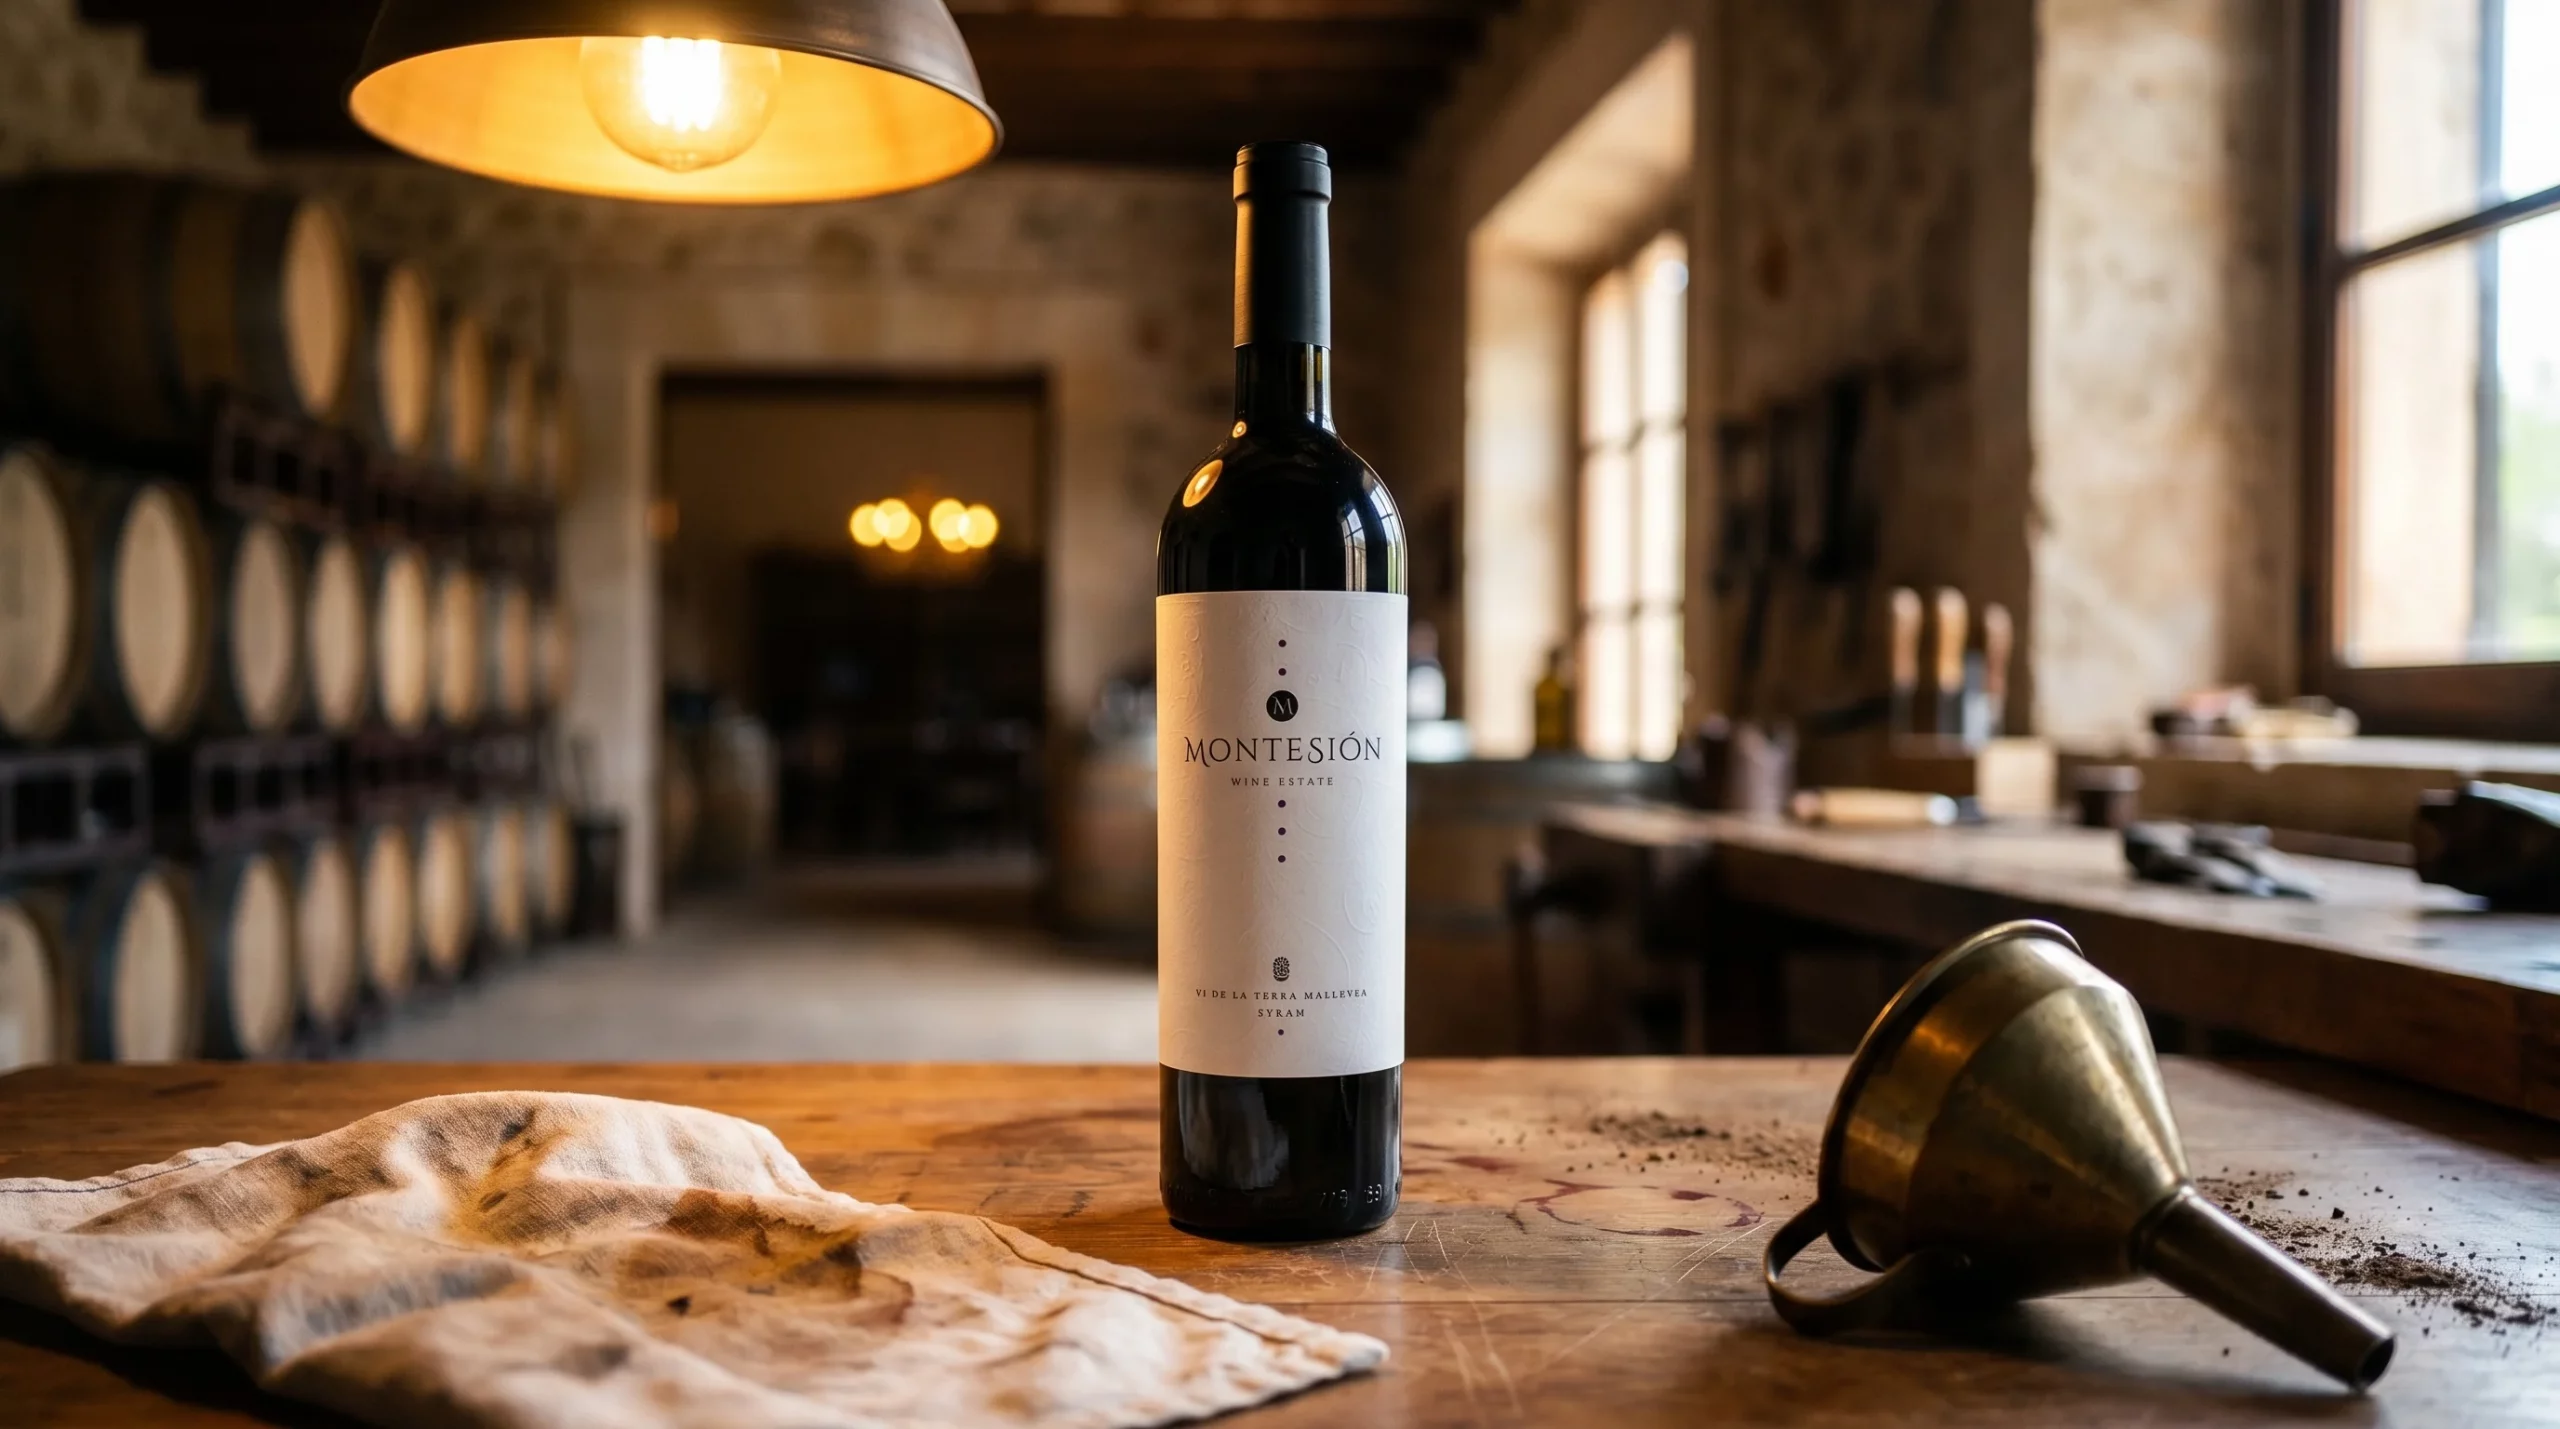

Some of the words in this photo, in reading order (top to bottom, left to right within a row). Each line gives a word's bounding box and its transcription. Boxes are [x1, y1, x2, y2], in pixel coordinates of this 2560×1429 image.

[1271, 696, 1294, 715] M
[1184, 731, 1382, 767] MONTESIÓN
[1231, 777, 1270, 786] WINE
[1279, 777, 1334, 786] ESTATE
[1196, 989, 1207, 998] VI
[1212, 990, 1226, 999] DE
[1232, 991, 1247, 1000] LA
[1254, 992, 1297, 1000] TERRA
[1258, 1009, 1305, 1018] SYRAM
